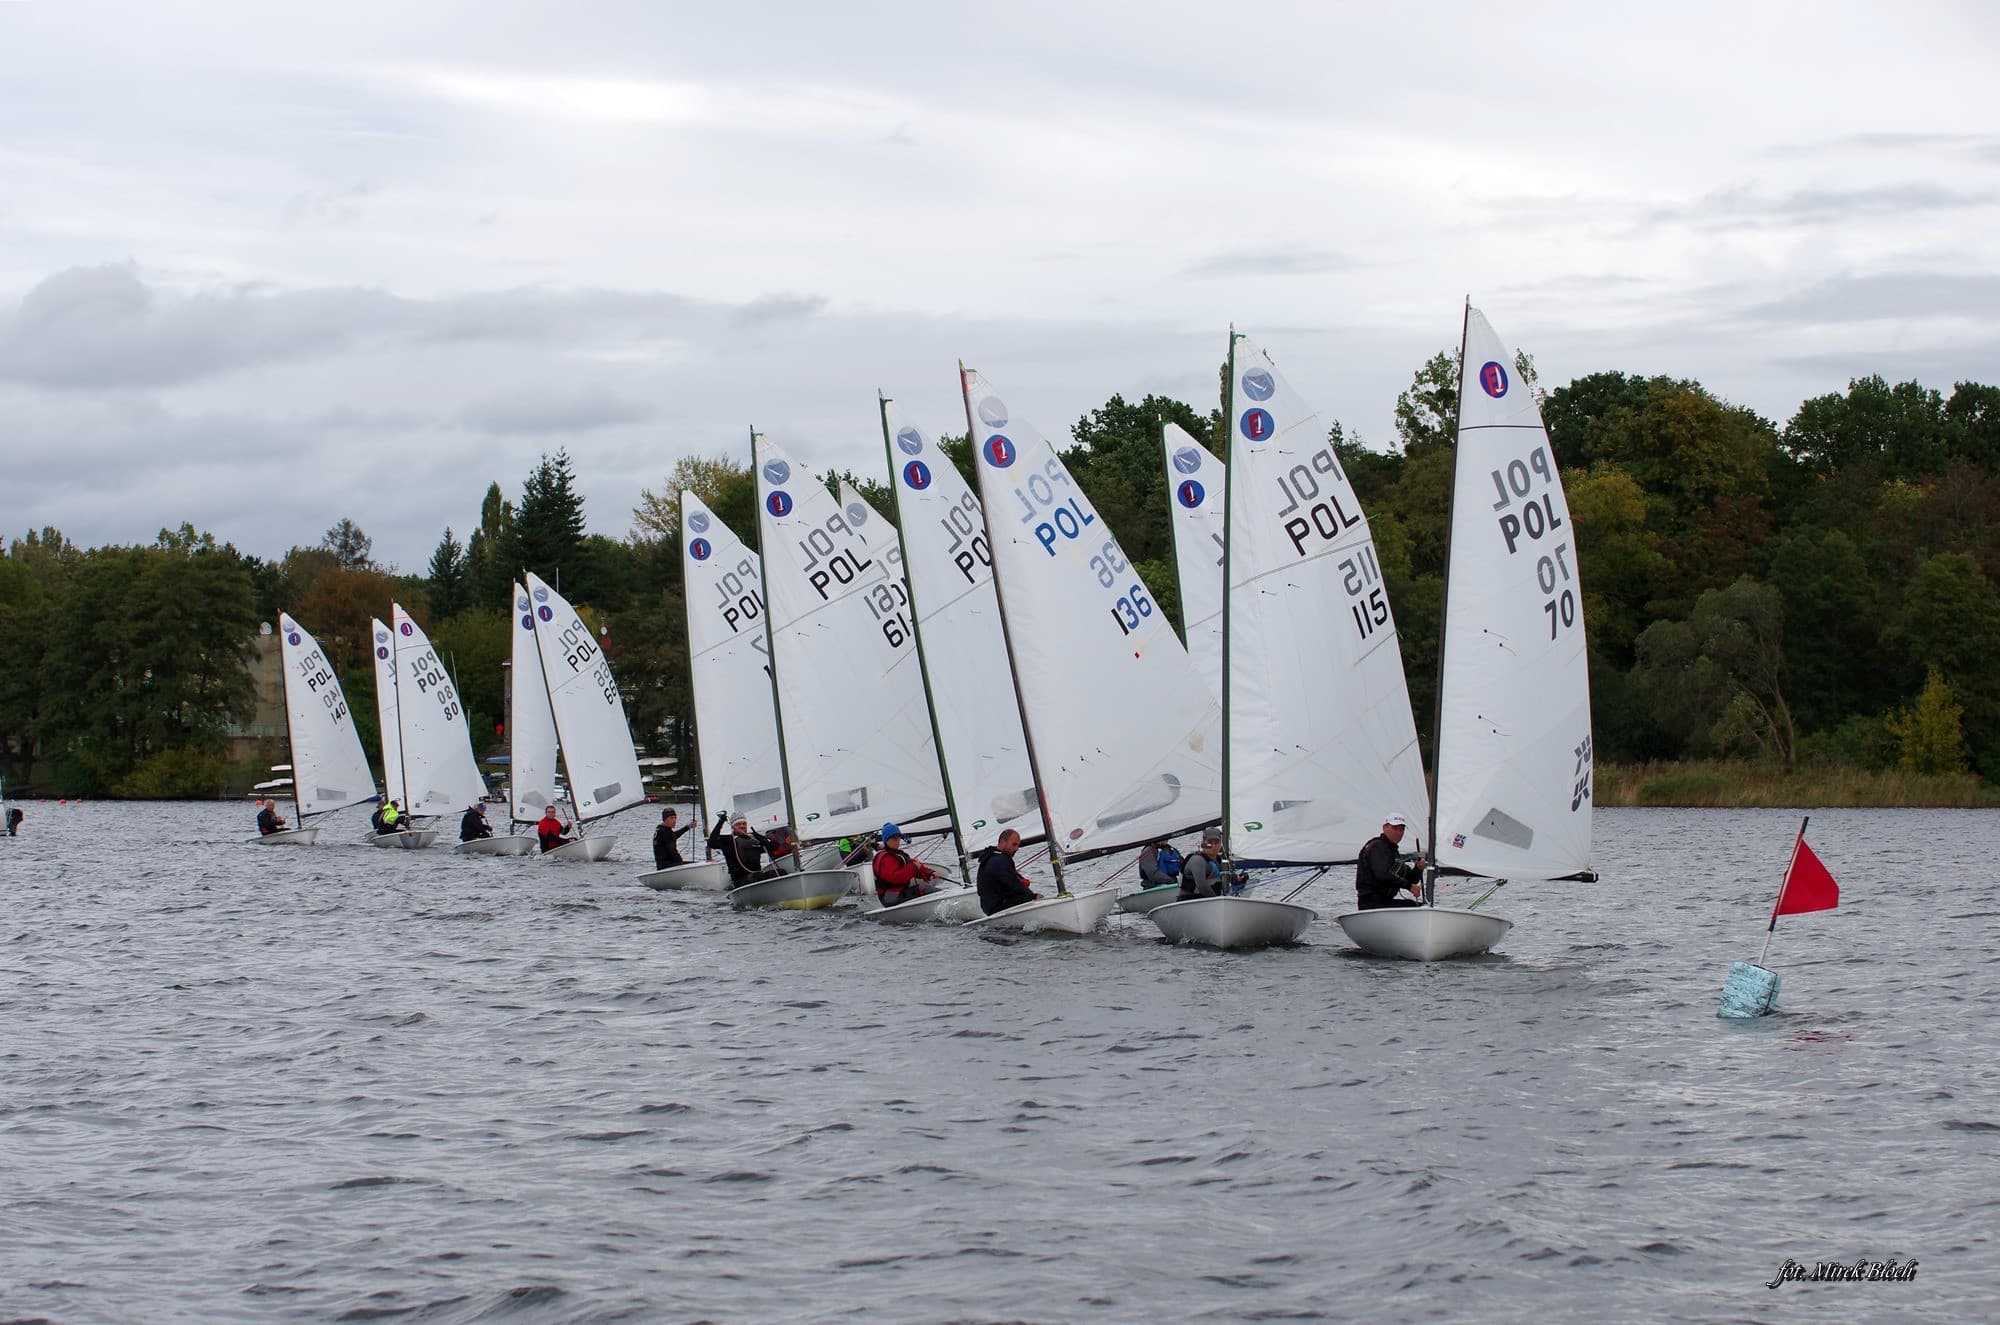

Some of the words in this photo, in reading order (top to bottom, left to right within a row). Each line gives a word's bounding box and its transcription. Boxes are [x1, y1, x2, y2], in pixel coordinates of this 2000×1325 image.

[1035, 497, 1094, 557] POL
[1284, 495, 1360, 556] POL
[1498, 493, 1561, 555] POL
[809, 549, 873, 600] POL
[954, 529, 992, 584] PO
[883, 612, 911, 648] 61
[1111, 584, 1152, 636] 136
[1352, 588, 1388, 640] 115
[1544, 589, 1574, 640] 70
[307, 668, 333, 693] POL
[417, 667, 445, 693] POL
[567, 639, 598, 673] POL
[330, 702, 347, 725] 140
[444, 702, 459, 722] 80
